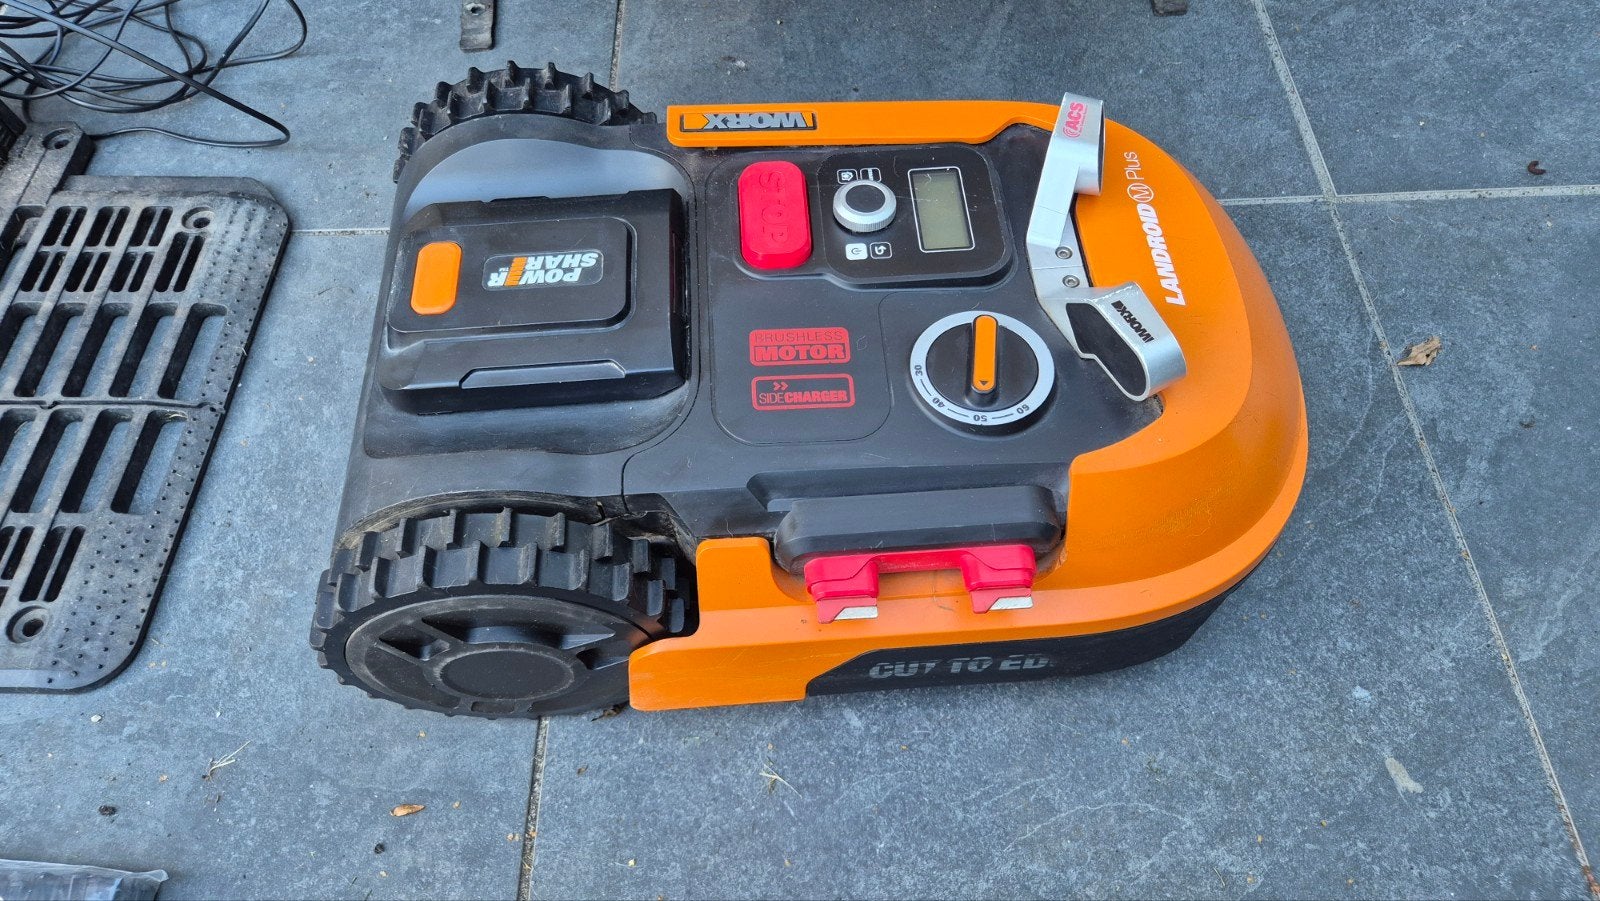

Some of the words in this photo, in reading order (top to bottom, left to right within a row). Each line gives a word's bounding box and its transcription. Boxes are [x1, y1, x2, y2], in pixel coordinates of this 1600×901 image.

[703, 112, 807, 130] WORX
[1065, 102, 1084, 131] ACS
[1124, 151, 1144, 180] Plus
[759, 171, 789, 243] STOP
[1129, 184, 1153, 203] M
[1136, 203, 1187, 306] LANDROID
[755, 330, 844, 343] BRUSHLESS
[1114, 302, 1153, 343] WORX
[755, 344, 845, 361] MOTOR
[914, 364, 923, 377] 30
[932, 397, 946, 408] 40
[973, 414, 988, 423] 50
[1016, 404, 1031, 415] 60
[869, 659, 941, 679] CUT
[949, 656, 993, 674] TO
[999, 654, 1053, 671] ED
